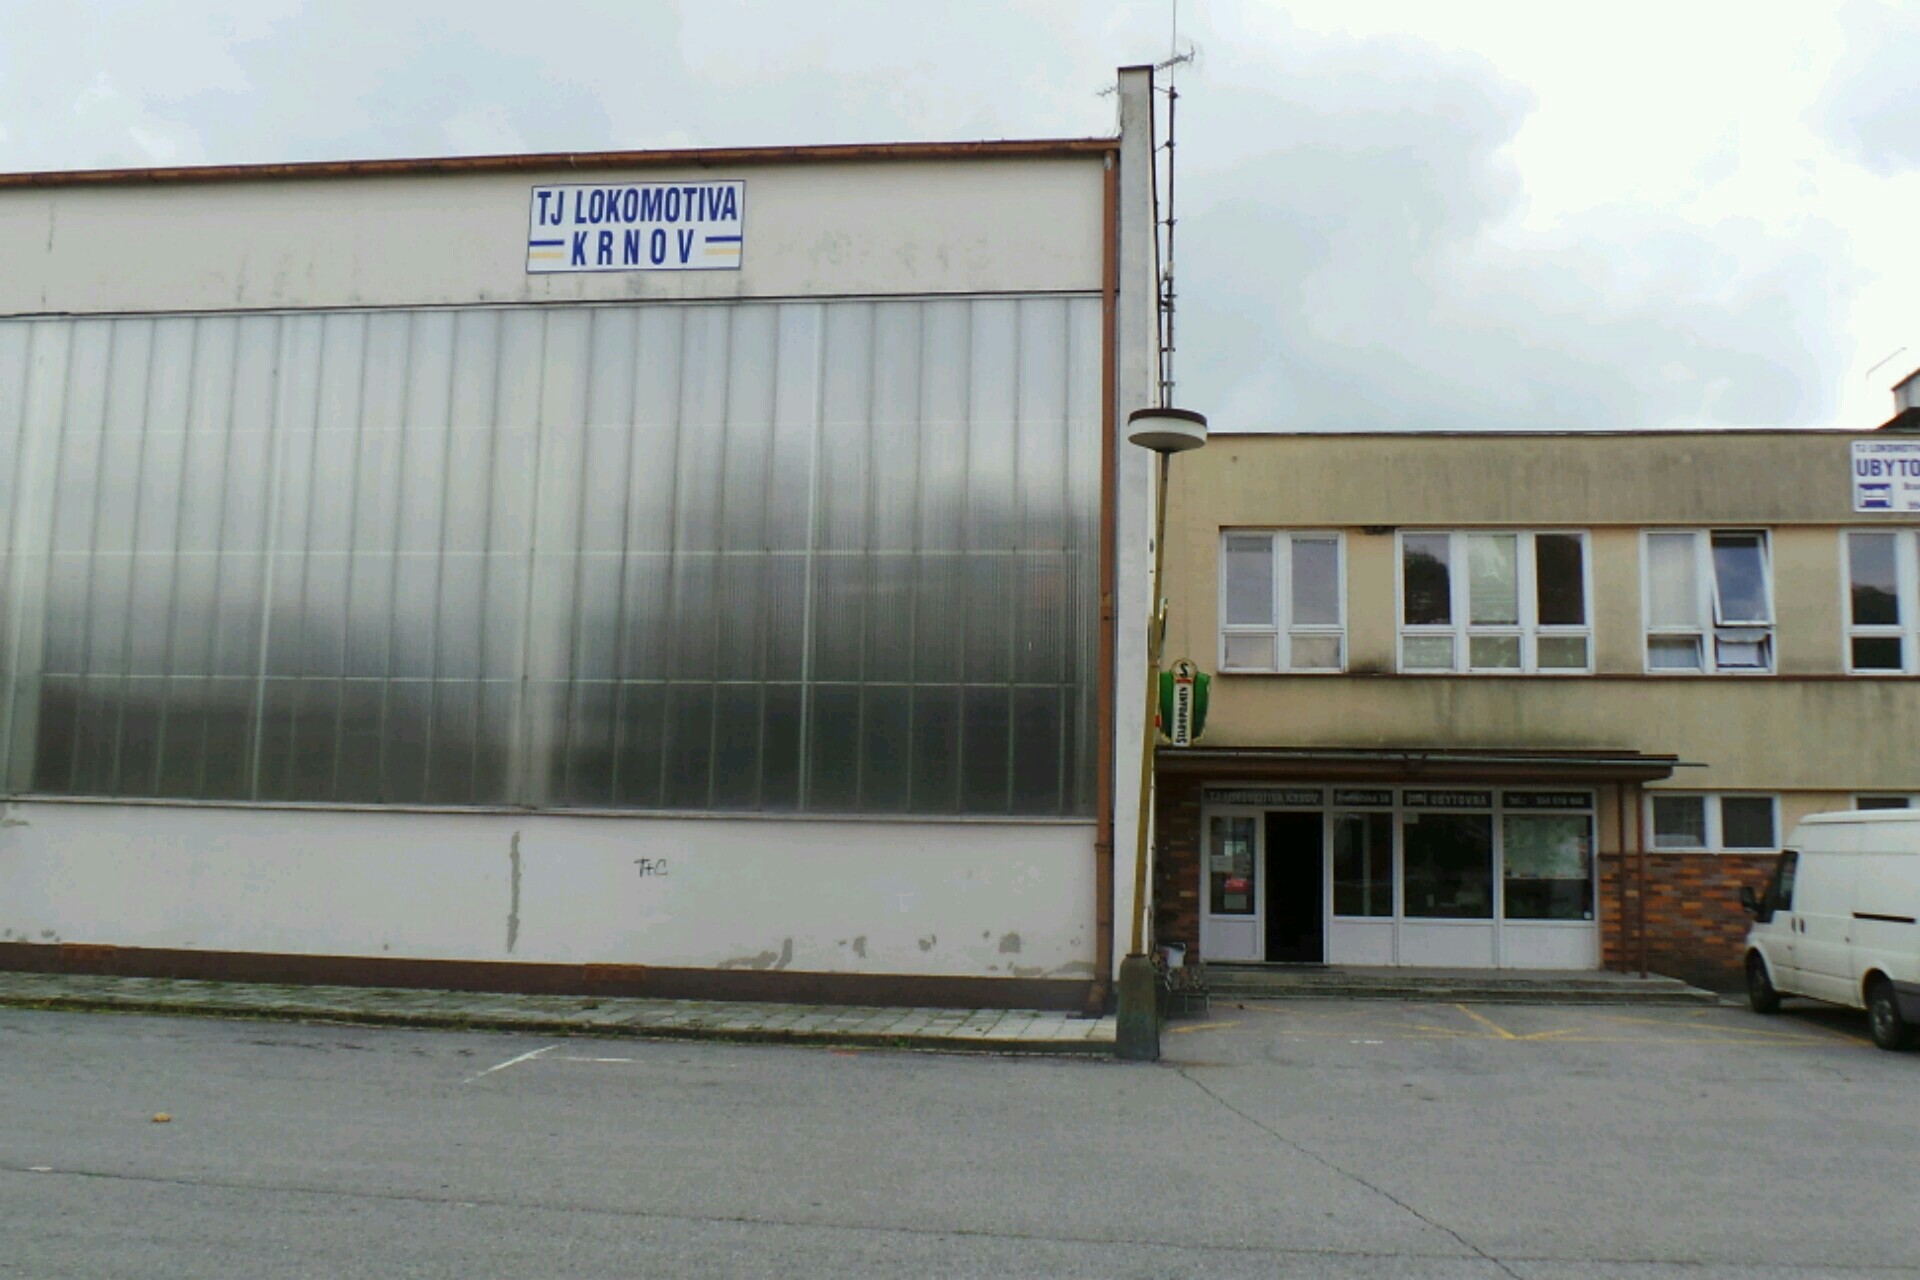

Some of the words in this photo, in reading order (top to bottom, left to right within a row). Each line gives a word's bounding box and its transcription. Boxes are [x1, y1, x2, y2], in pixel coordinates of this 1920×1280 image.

[537, 191, 565, 225] TJ
[575, 186, 737, 224] LOKOMOTIVA
[571, 229, 694, 265] KRNOV
[1856, 458, 1920, 477] UBYTO
